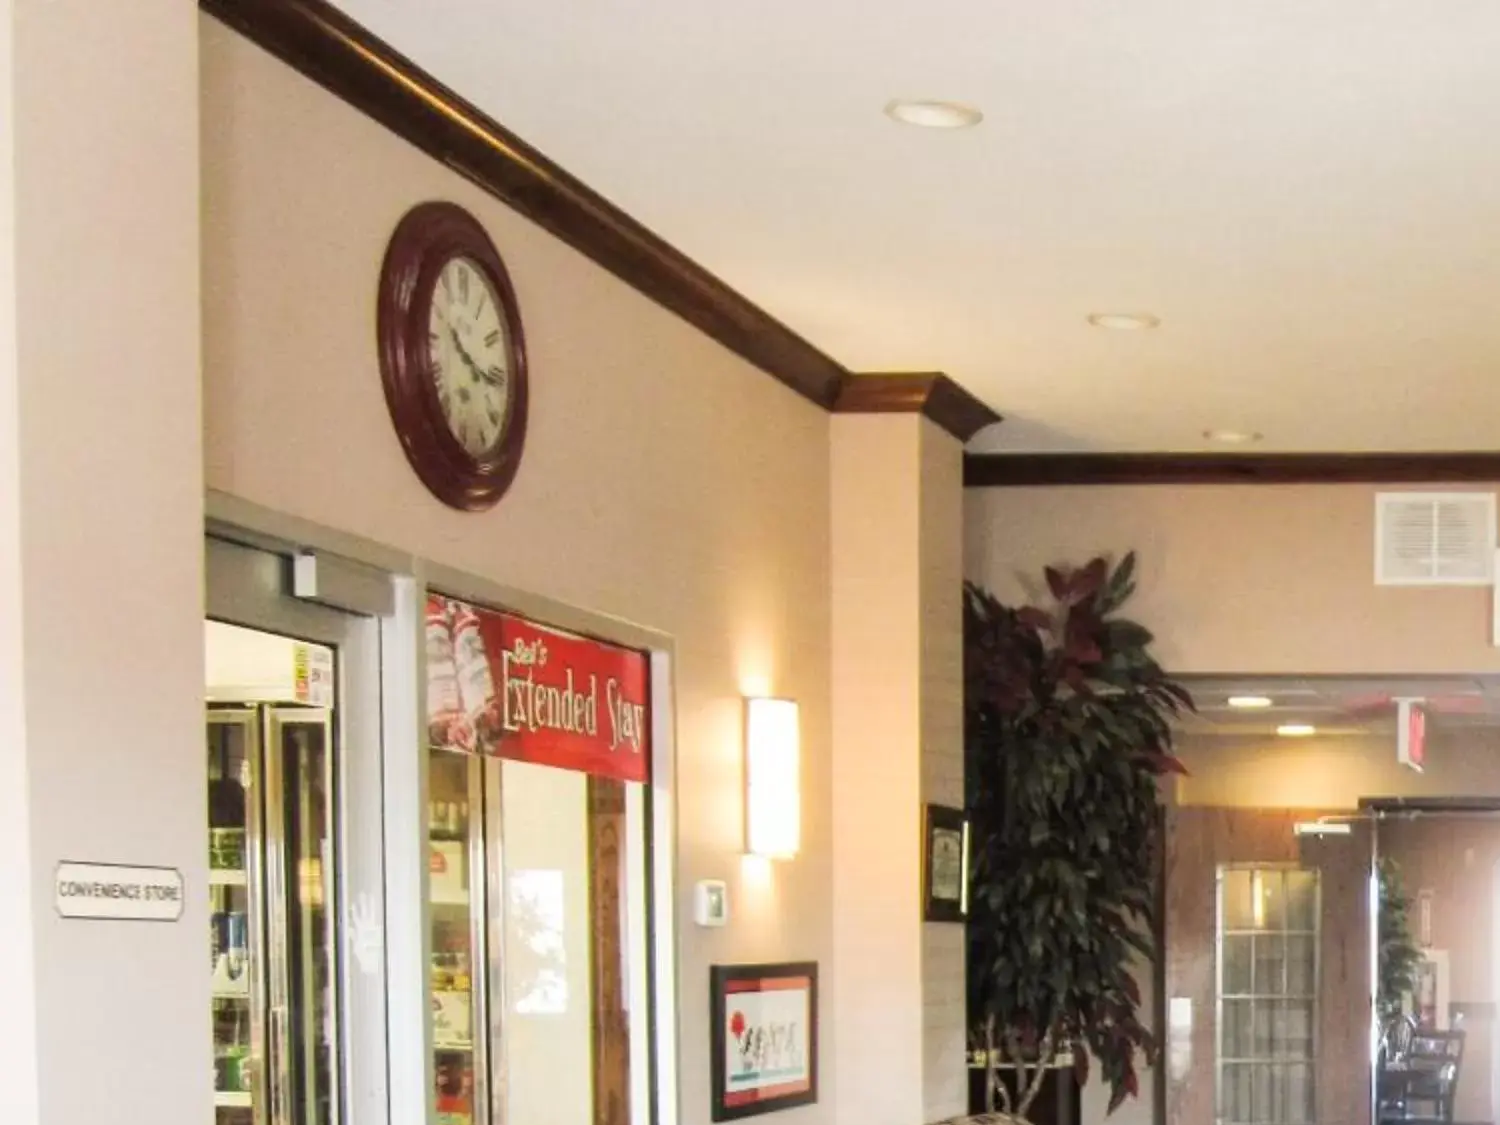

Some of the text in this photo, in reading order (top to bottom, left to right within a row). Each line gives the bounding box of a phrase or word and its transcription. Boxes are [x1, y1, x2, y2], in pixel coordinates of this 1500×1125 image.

[501, 649, 645, 753] Extended Stay
[59, 880, 181, 902] CONVENIENCE STORE
